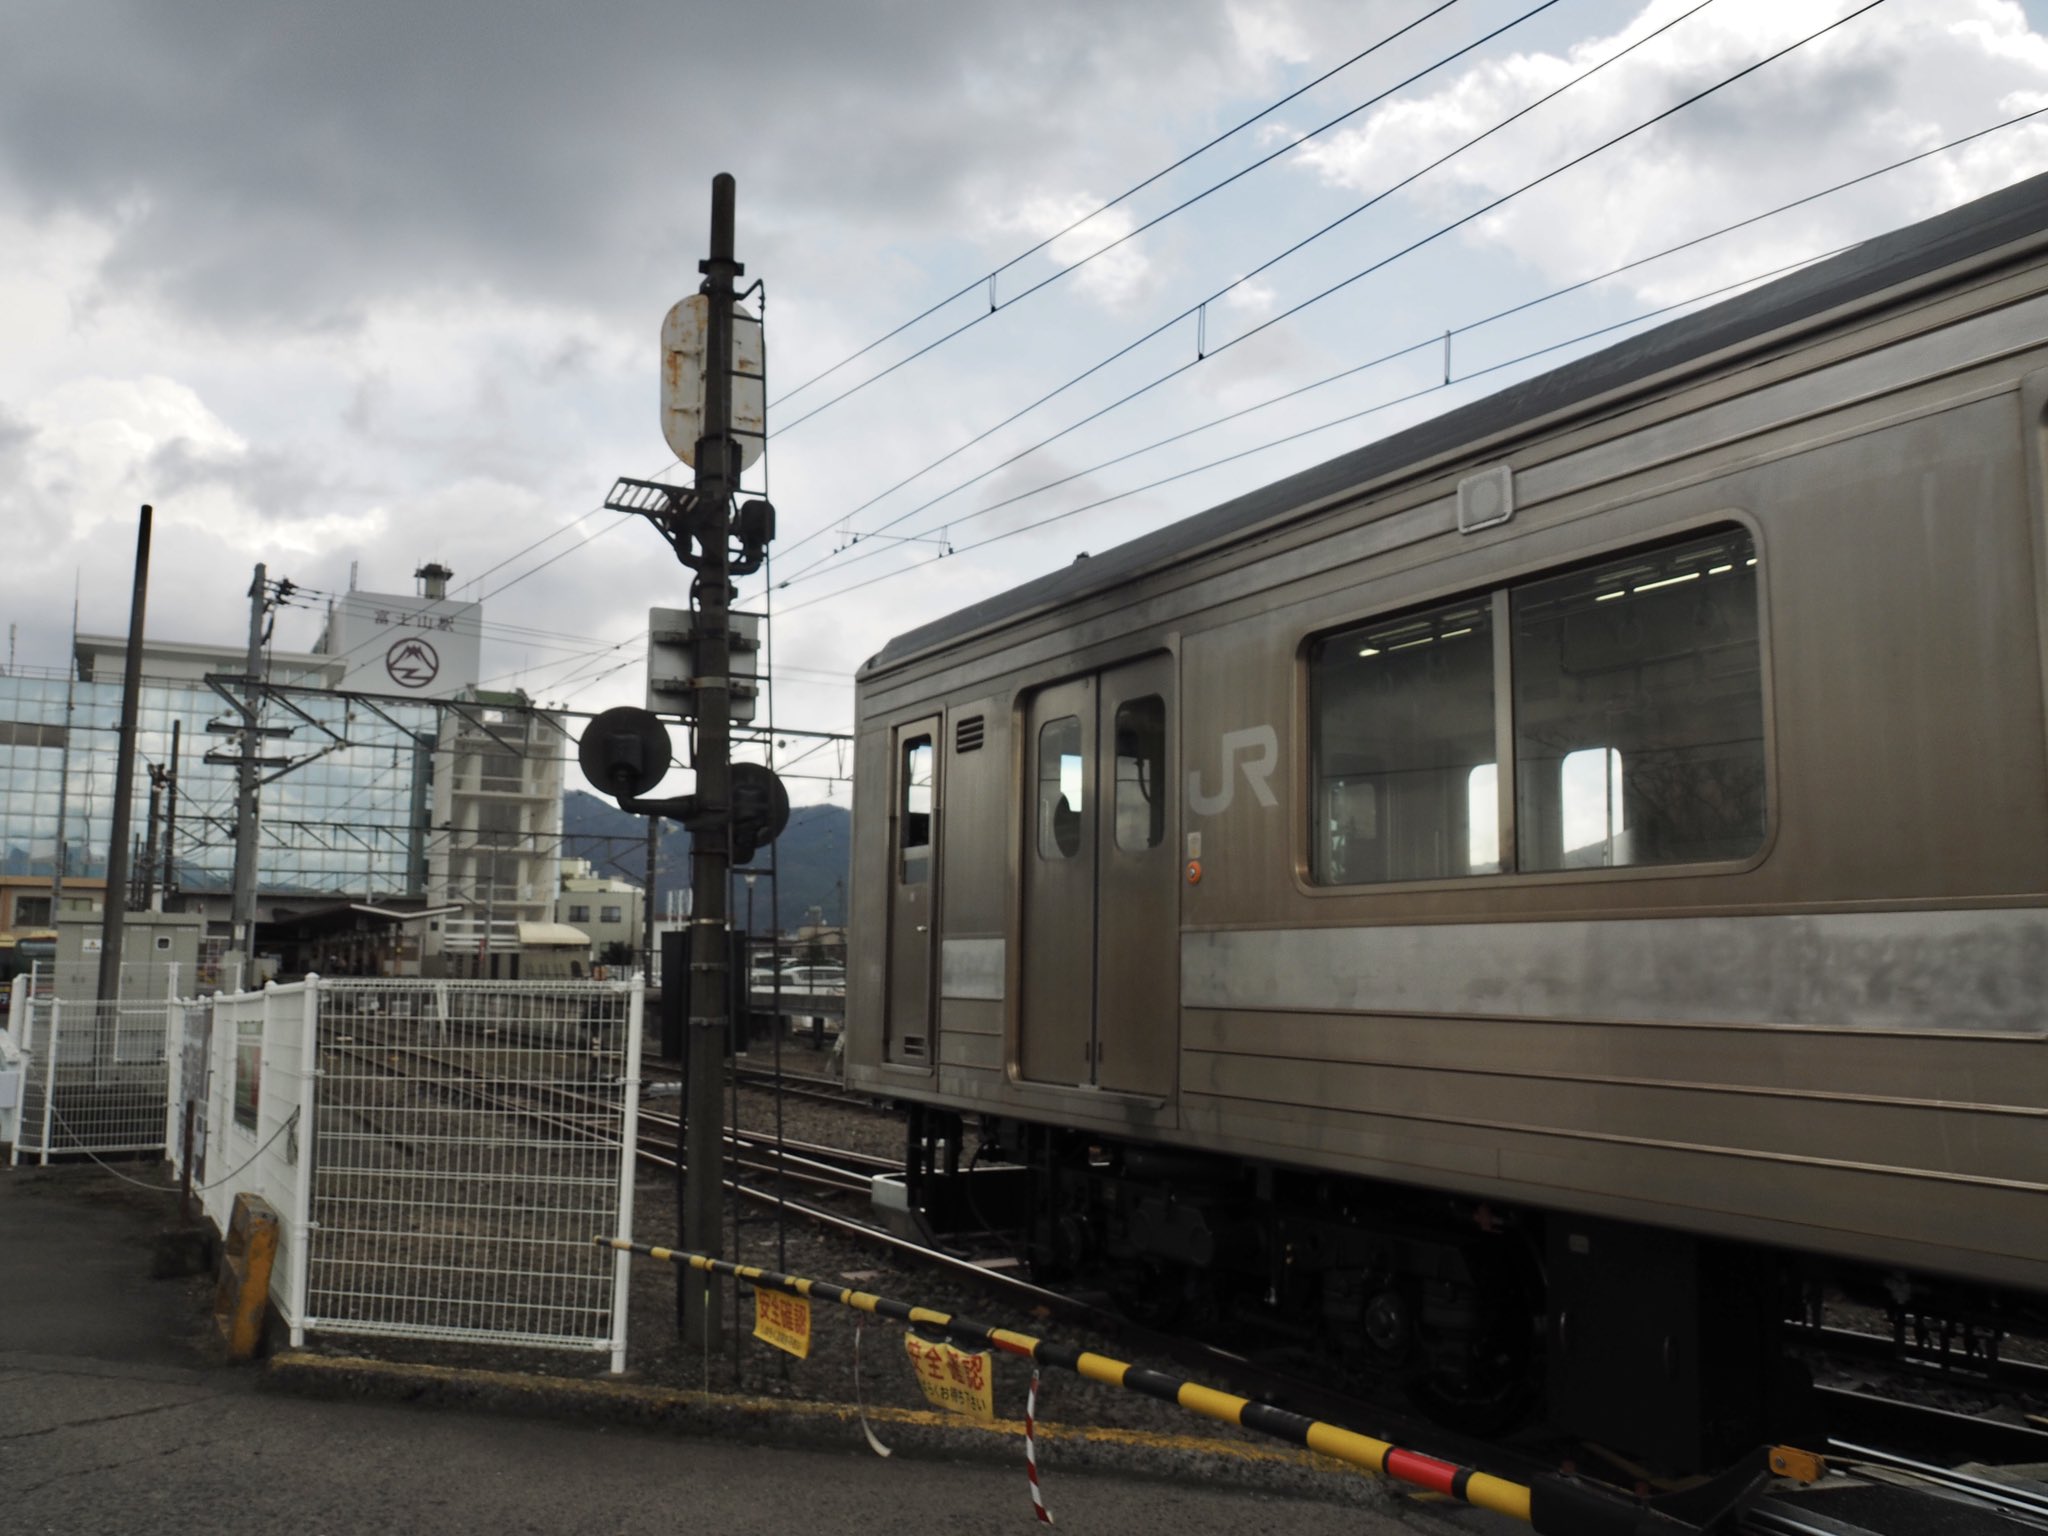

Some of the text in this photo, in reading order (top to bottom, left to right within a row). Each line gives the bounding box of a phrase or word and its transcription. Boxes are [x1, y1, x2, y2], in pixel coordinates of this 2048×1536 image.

[1188, 724, 1279, 816] JR
[759, 1291, 806, 1336] 安全確認
[908, 1340, 984, 1391] 安全確認
